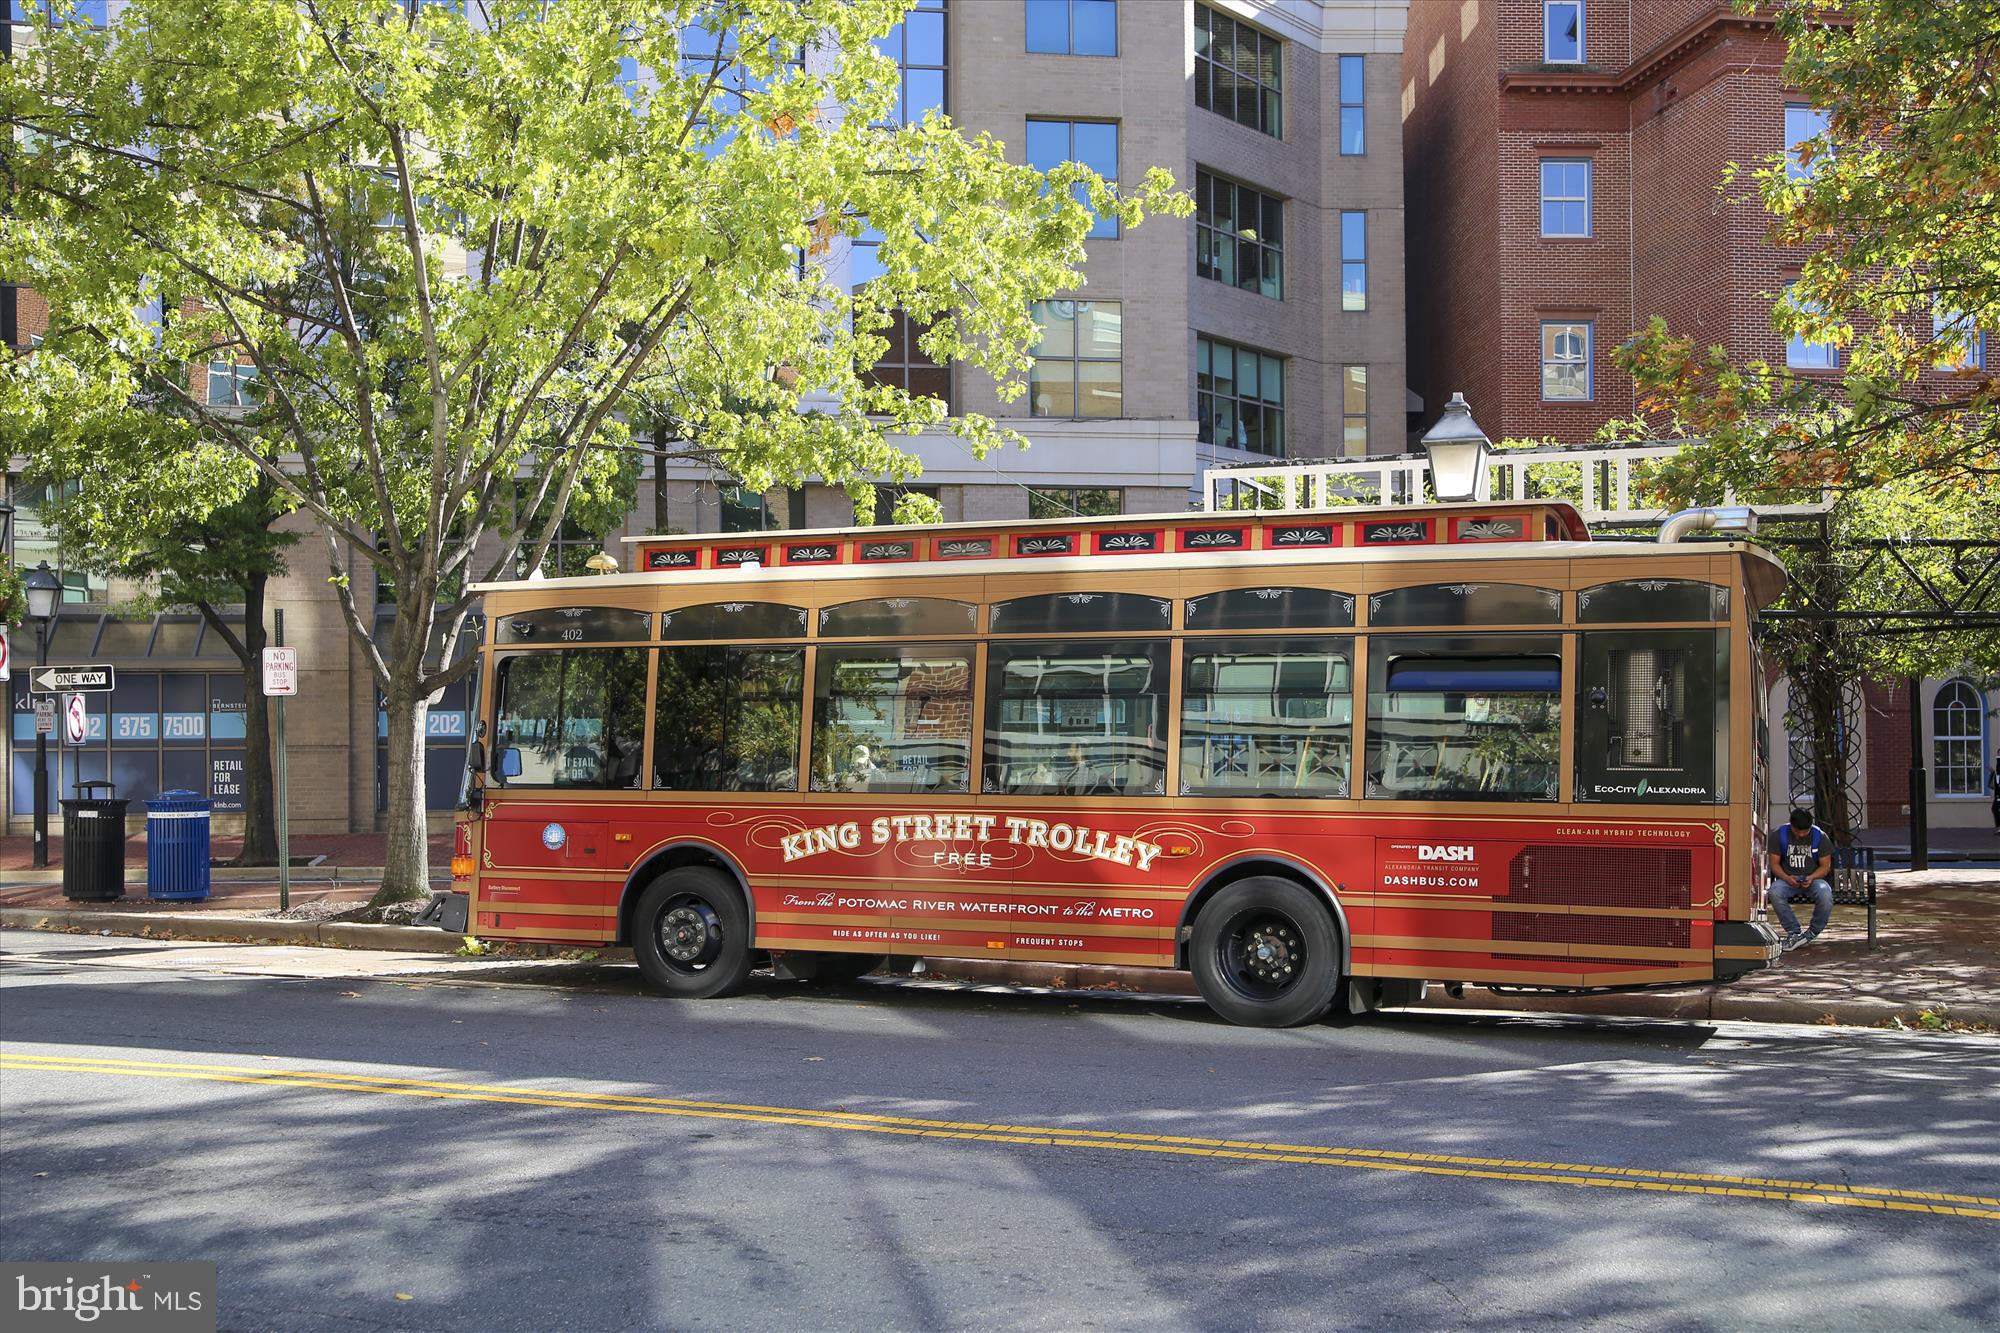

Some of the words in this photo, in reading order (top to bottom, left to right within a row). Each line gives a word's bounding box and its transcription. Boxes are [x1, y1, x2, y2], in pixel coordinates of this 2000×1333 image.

[562, 629, 583, 640] 402
[273, 652, 286, 660] NO
[266, 662, 294, 671] PARKING
[55, 674, 78, 684] ONE
[81, 673, 104, 683] WAY
[119, 716, 151, 736] 375
[164, 716, 204, 736] 7500
[429, 714, 461, 734] 202
[214, 760, 243, 770] RETAIL
[902, 754, 929, 765] RETAIL
[214, 772, 231, 782] FOR
[214, 784, 240, 794] LEASE
[213, 801, 242, 809] klnb.com
[1556, 828, 1600, 836] CLEAN-AIR
[1637, 829, 1691, 838] TECHNOLOGY
[781, 822, 861, 863] KING
[871, 813, 996, 844] STREET
[1005, 816, 1162, 872] TROLLEY
[1418, 845, 1474, 861] DASH
[933, 852, 992, 866] FREE
[1384, 876, 1478, 887] DASHBUS.COM
[783, 894, 816, 907] From
[838, 897, 908, 910] POTOMAC
[913, 899, 956, 911] RIVER
[959, 902, 1059, 915] WATERFRONT
[1062, 906, 1074, 916] to
[1099, 907, 1154, 919] METRO
[833, 929, 850, 937] RIDE
[852, 930, 862, 938] AS
[865, 931, 888, 939] OFTEN
[903, 932, 918, 940] YOU
[920, 933, 940, 941] LIKE!
[1016, 937, 1056, 946] FREQUENT
[1058, 938, 1084, 947] STOPS
